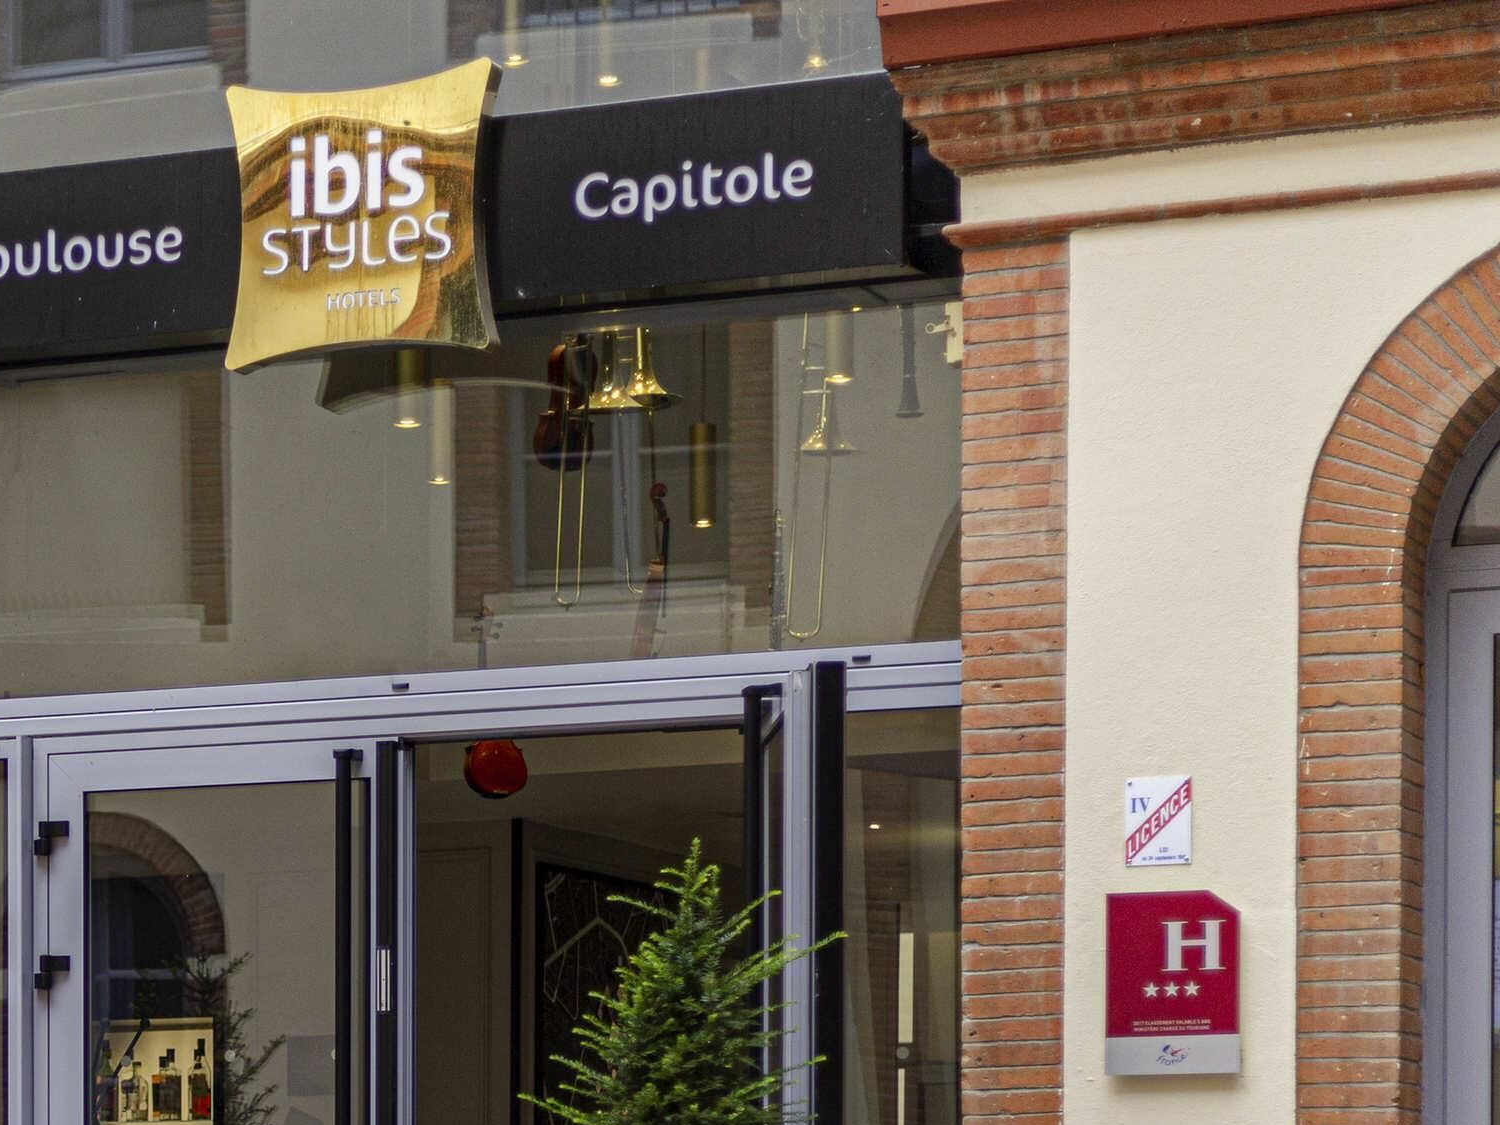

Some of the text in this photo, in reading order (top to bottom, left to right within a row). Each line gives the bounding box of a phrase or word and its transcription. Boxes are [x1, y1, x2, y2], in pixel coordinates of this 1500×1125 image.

[290, 128, 425, 218] ibis
[575, 151, 814, 223] Capitole
[326, 287, 402, 312] HOTELS
[1128, 783, 1190, 859] LICENCE
[1130, 796, 1153, 814] IV
[1160, 918, 1228, 973] H
